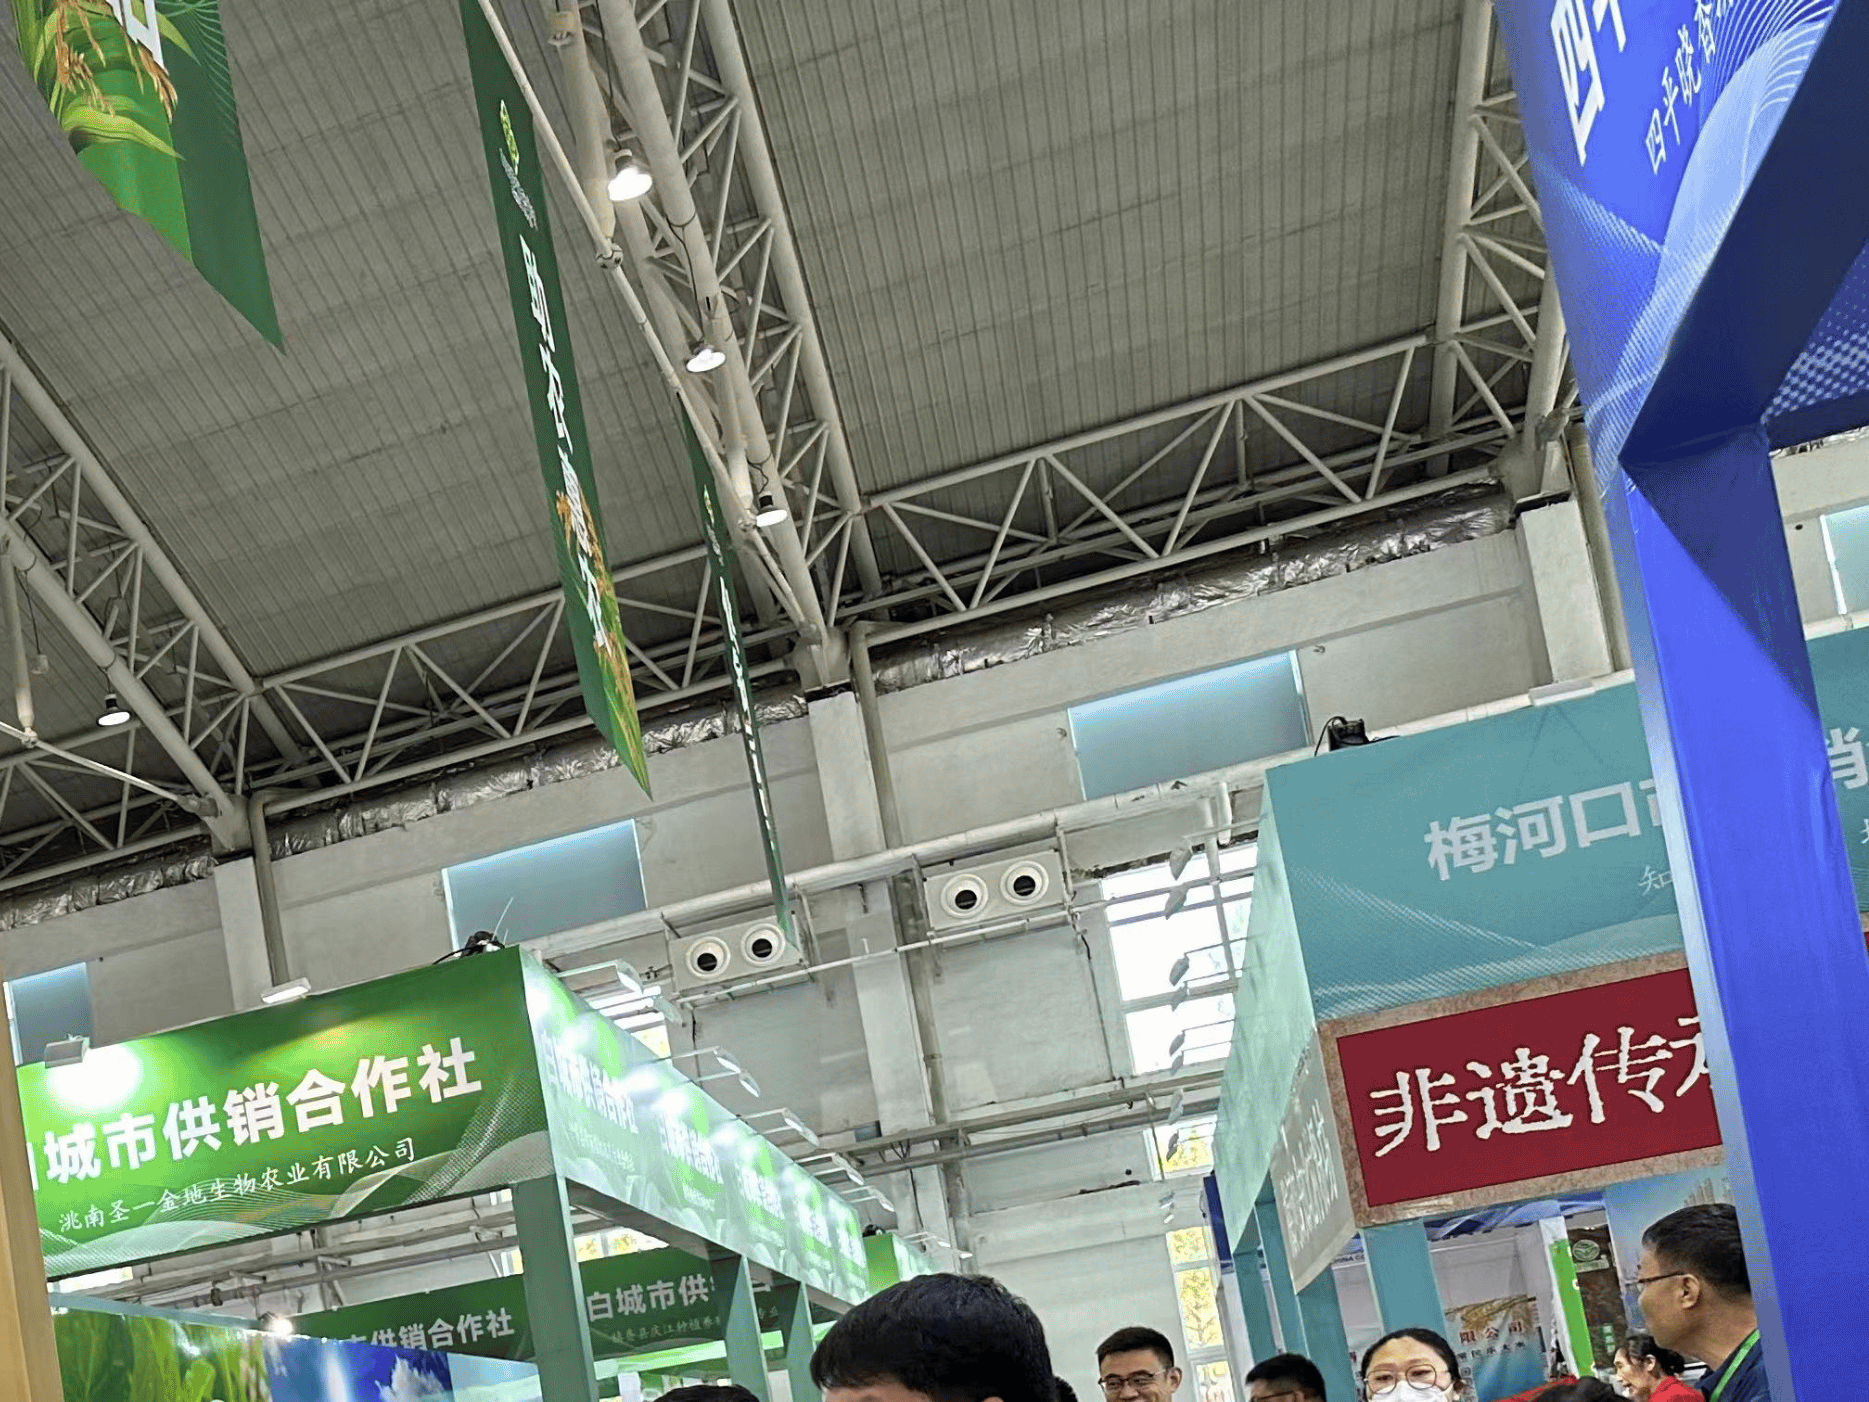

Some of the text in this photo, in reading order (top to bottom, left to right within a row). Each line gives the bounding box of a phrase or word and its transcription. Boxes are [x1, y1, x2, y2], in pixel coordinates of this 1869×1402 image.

[27, 1037, 482, 1190] 城市供销合作社
[586, 1273, 716, 1322] 白城市供
